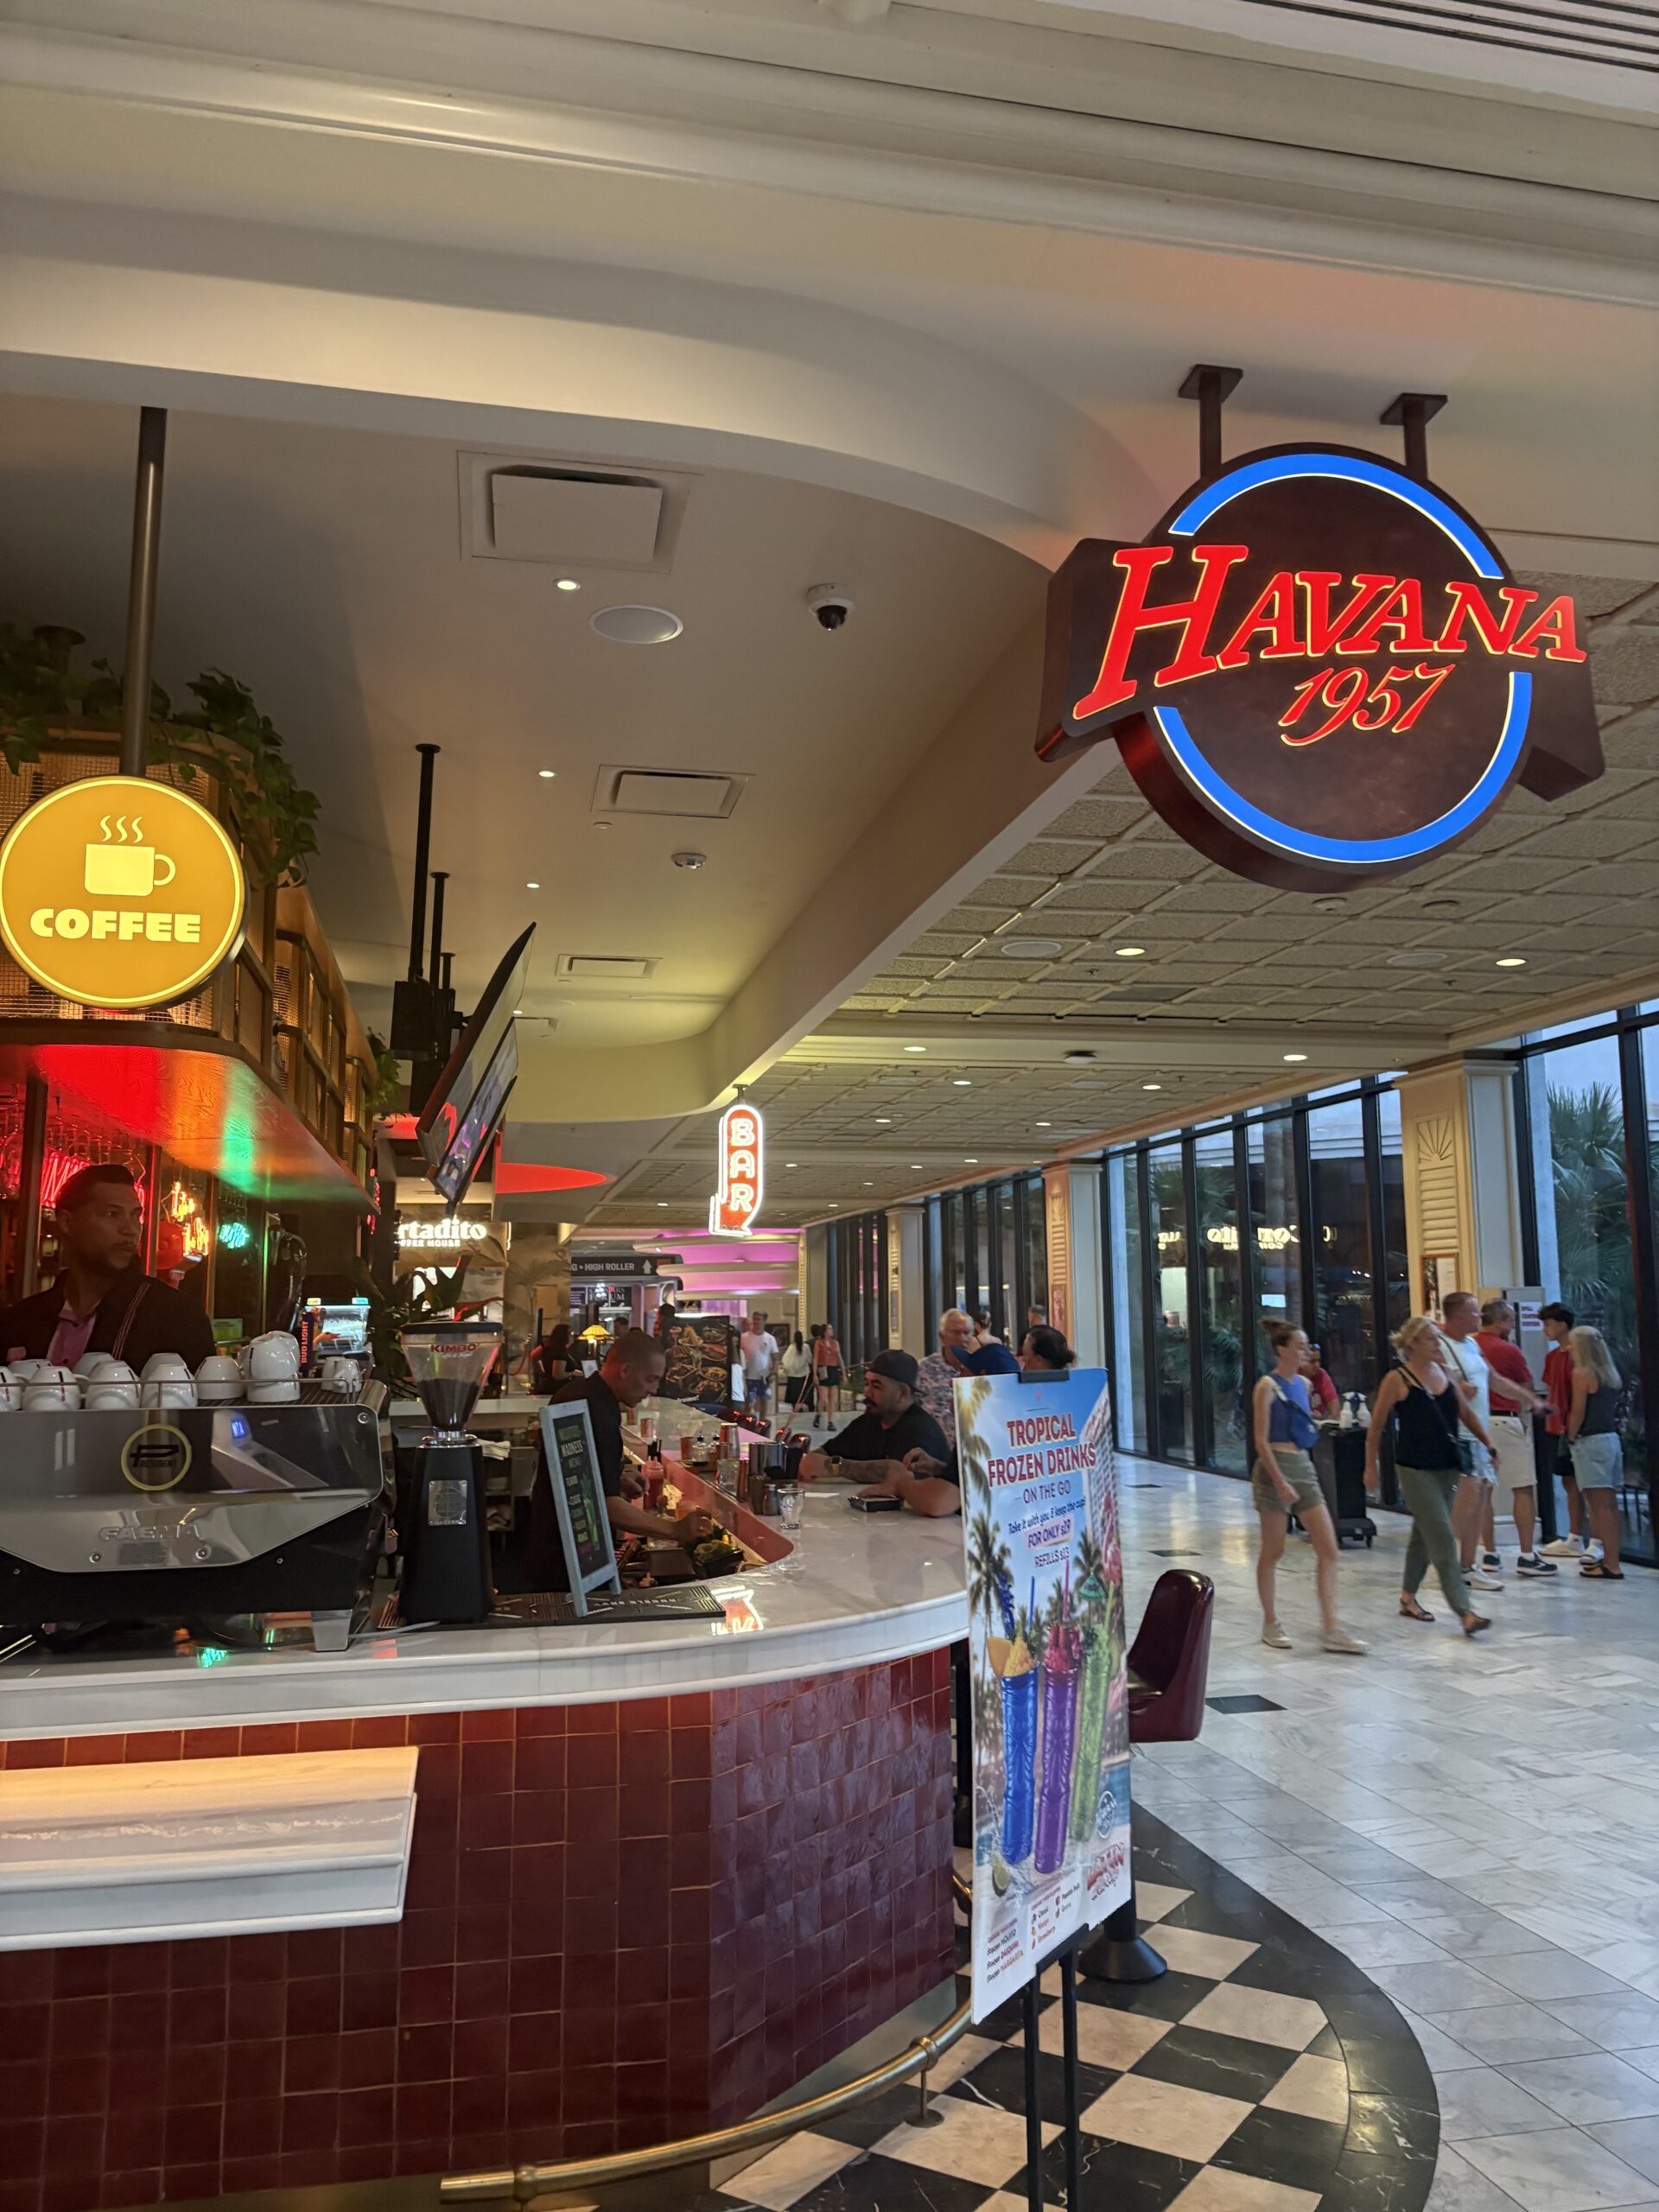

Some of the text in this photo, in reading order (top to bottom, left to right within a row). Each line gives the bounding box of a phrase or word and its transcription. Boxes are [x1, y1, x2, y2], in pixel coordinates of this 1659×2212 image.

[1072, 544, 1587, 720] HAVANA
[1278, 662, 1456, 746] 1957
[29, 908, 201, 944] COFFEE
[730, 1117, 755, 1211] BAR
[397, 1213, 487, 1240] rtadito
[584, 1262, 604, 1272] HIGH
[605, 1262, 635, 1271] ROLLER
[430, 1344, 476, 1353] KIMBO
[1007, 1413, 1076, 1447] TROPICAL
[988, 1442, 1096, 1488] FROZEN DRINKS
[1023, 1479, 1071, 1504] ON THE GO
[1008, 1521, 1021, 1535] Take
[1027, 1513, 1039, 1529] with
[1039, 1512, 1050, 1527] you
[1055, 1505, 1067, 1518] keep
[1027, 1530, 1042, 1549] FOR
[1042, 1523, 1061, 1543] ONLY
